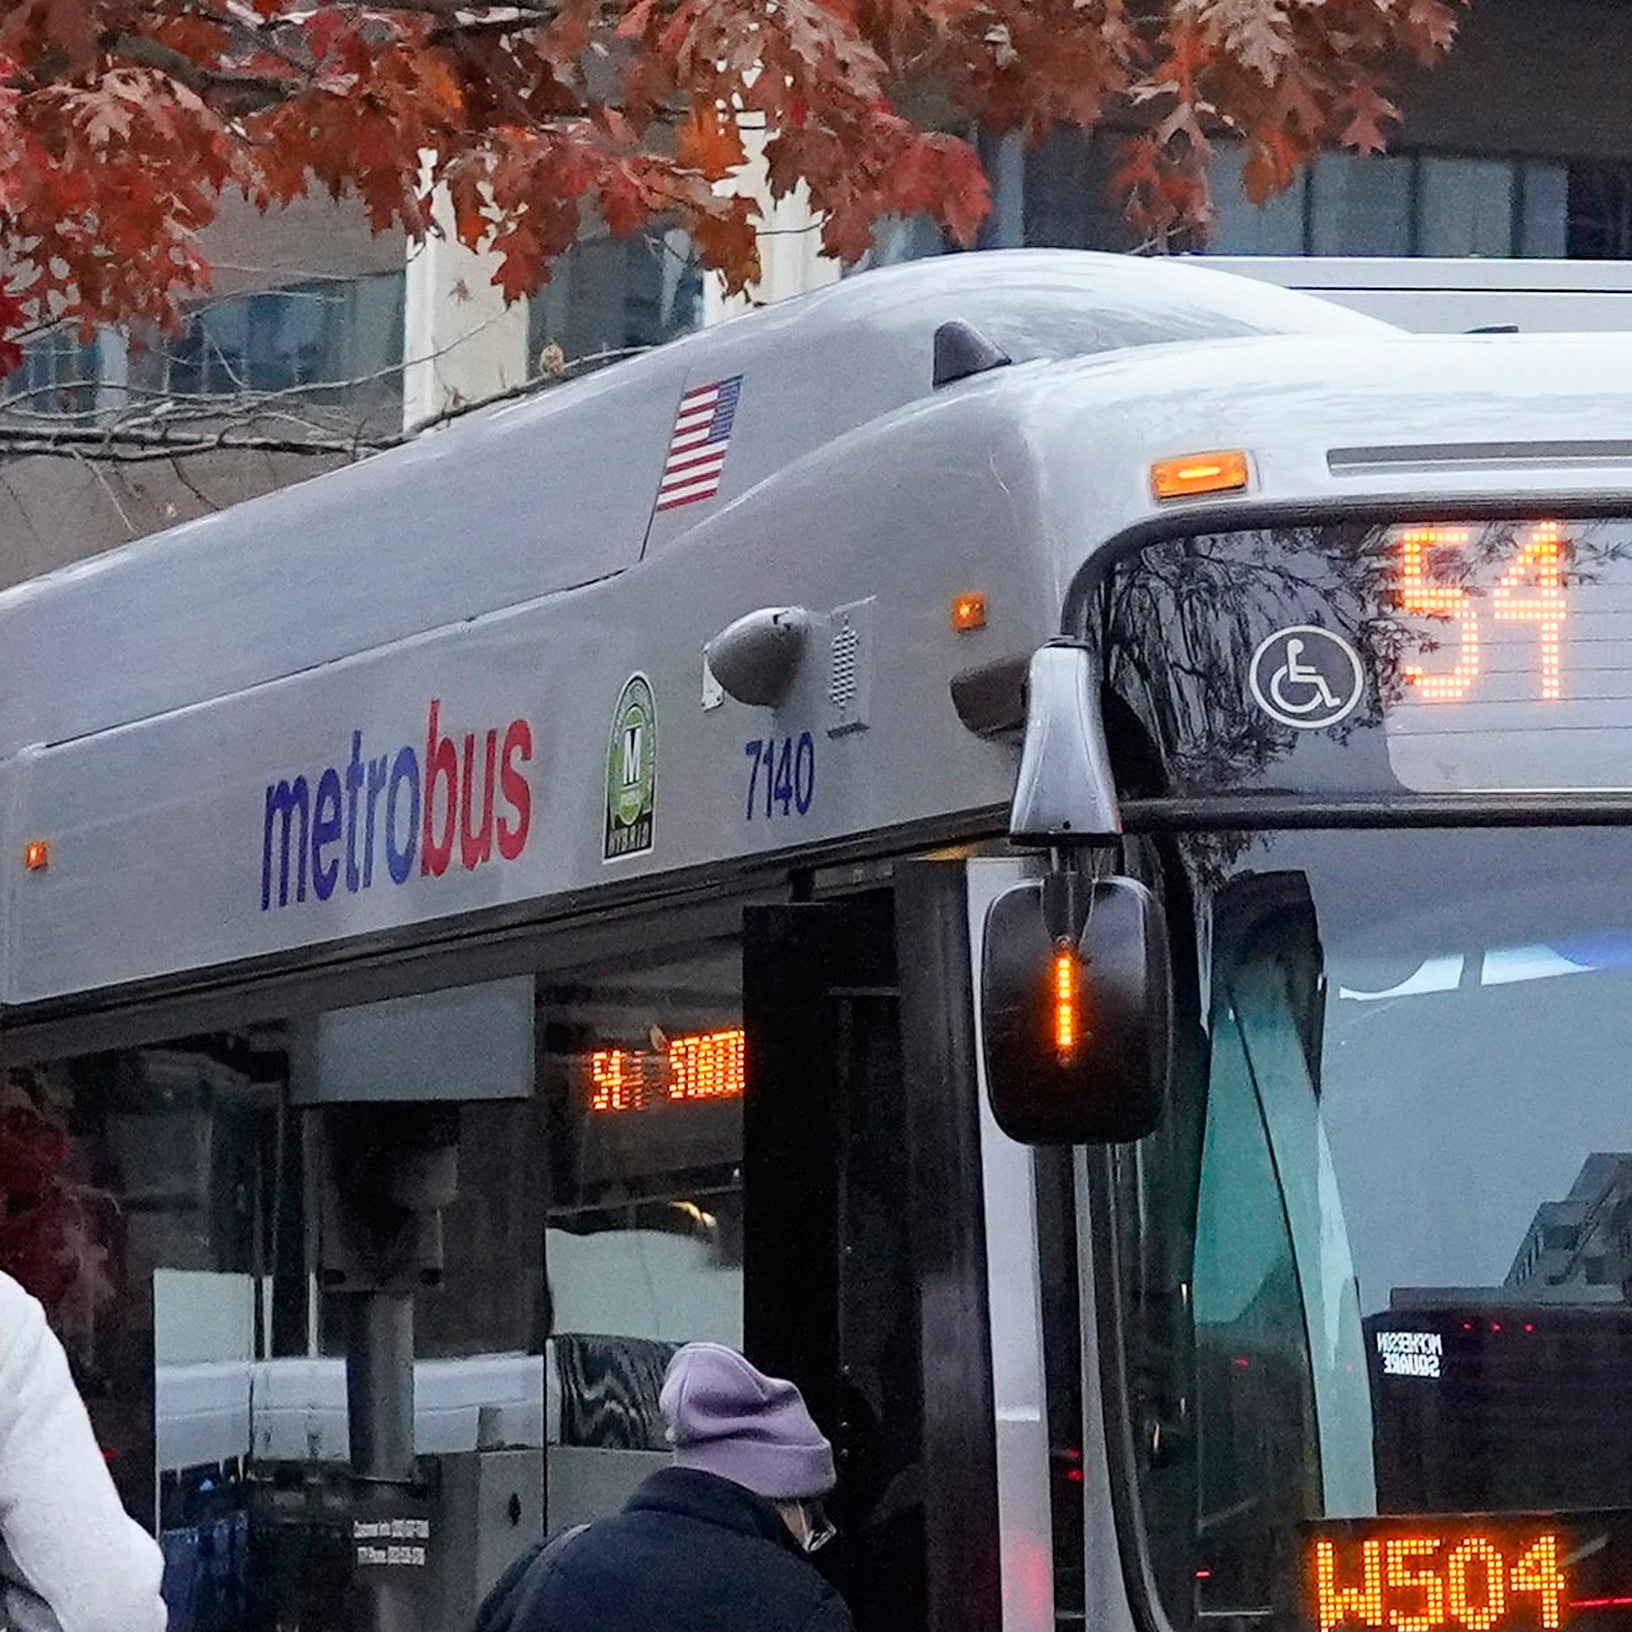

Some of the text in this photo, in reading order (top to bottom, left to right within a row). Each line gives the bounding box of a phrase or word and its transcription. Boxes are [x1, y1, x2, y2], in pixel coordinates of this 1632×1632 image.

[1404, 520, 1566, 698] 54
[260, 698, 532, 910] metrobus
[743, 731, 815, 821] 7140
